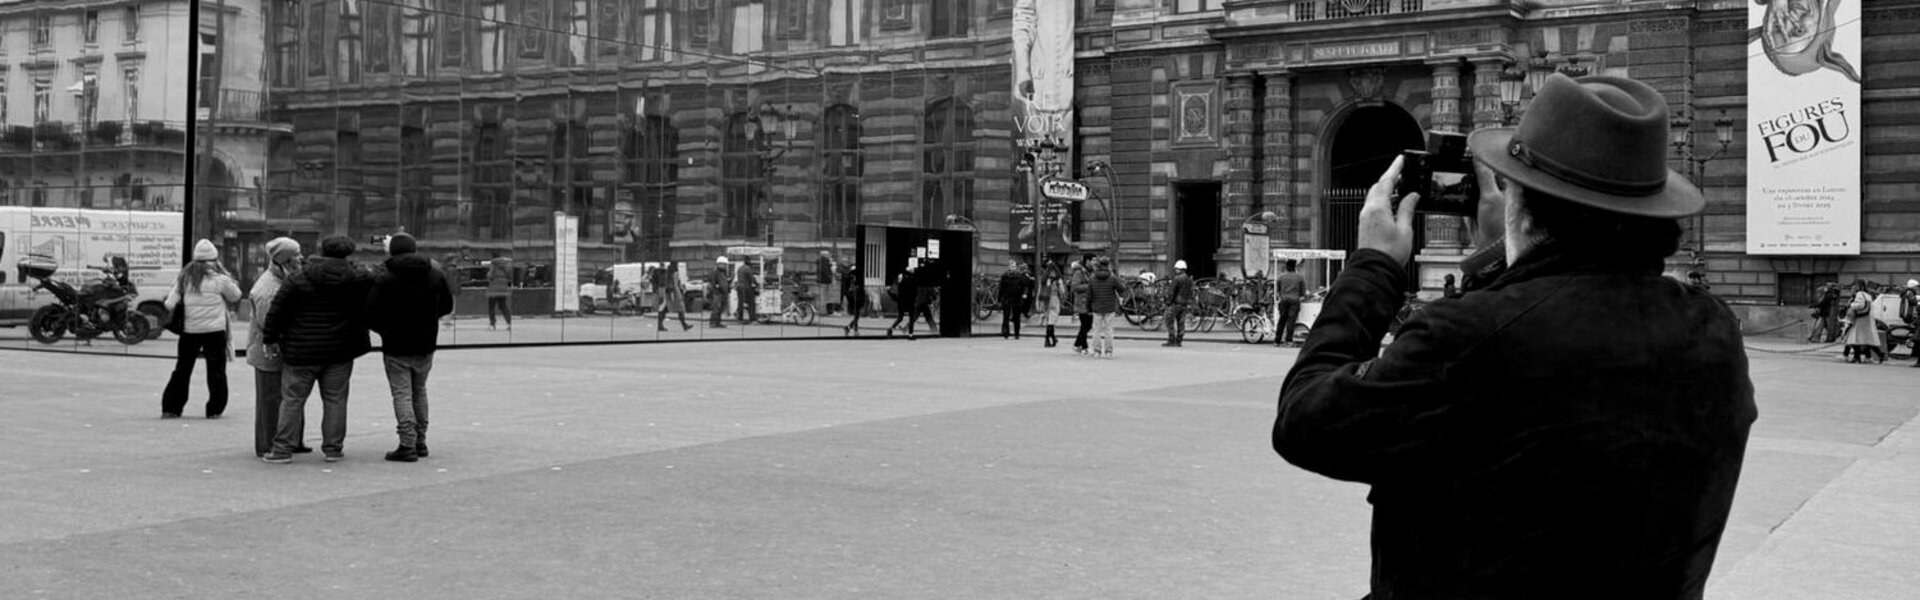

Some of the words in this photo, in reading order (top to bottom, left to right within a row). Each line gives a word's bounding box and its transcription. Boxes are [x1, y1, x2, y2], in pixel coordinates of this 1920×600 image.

[1013, 115, 1065, 132] VOIR
[1757, 97, 1844, 135] FIGURES
[1763, 110, 1849, 163] FOU
[1795, 132, 1811, 144] DU
